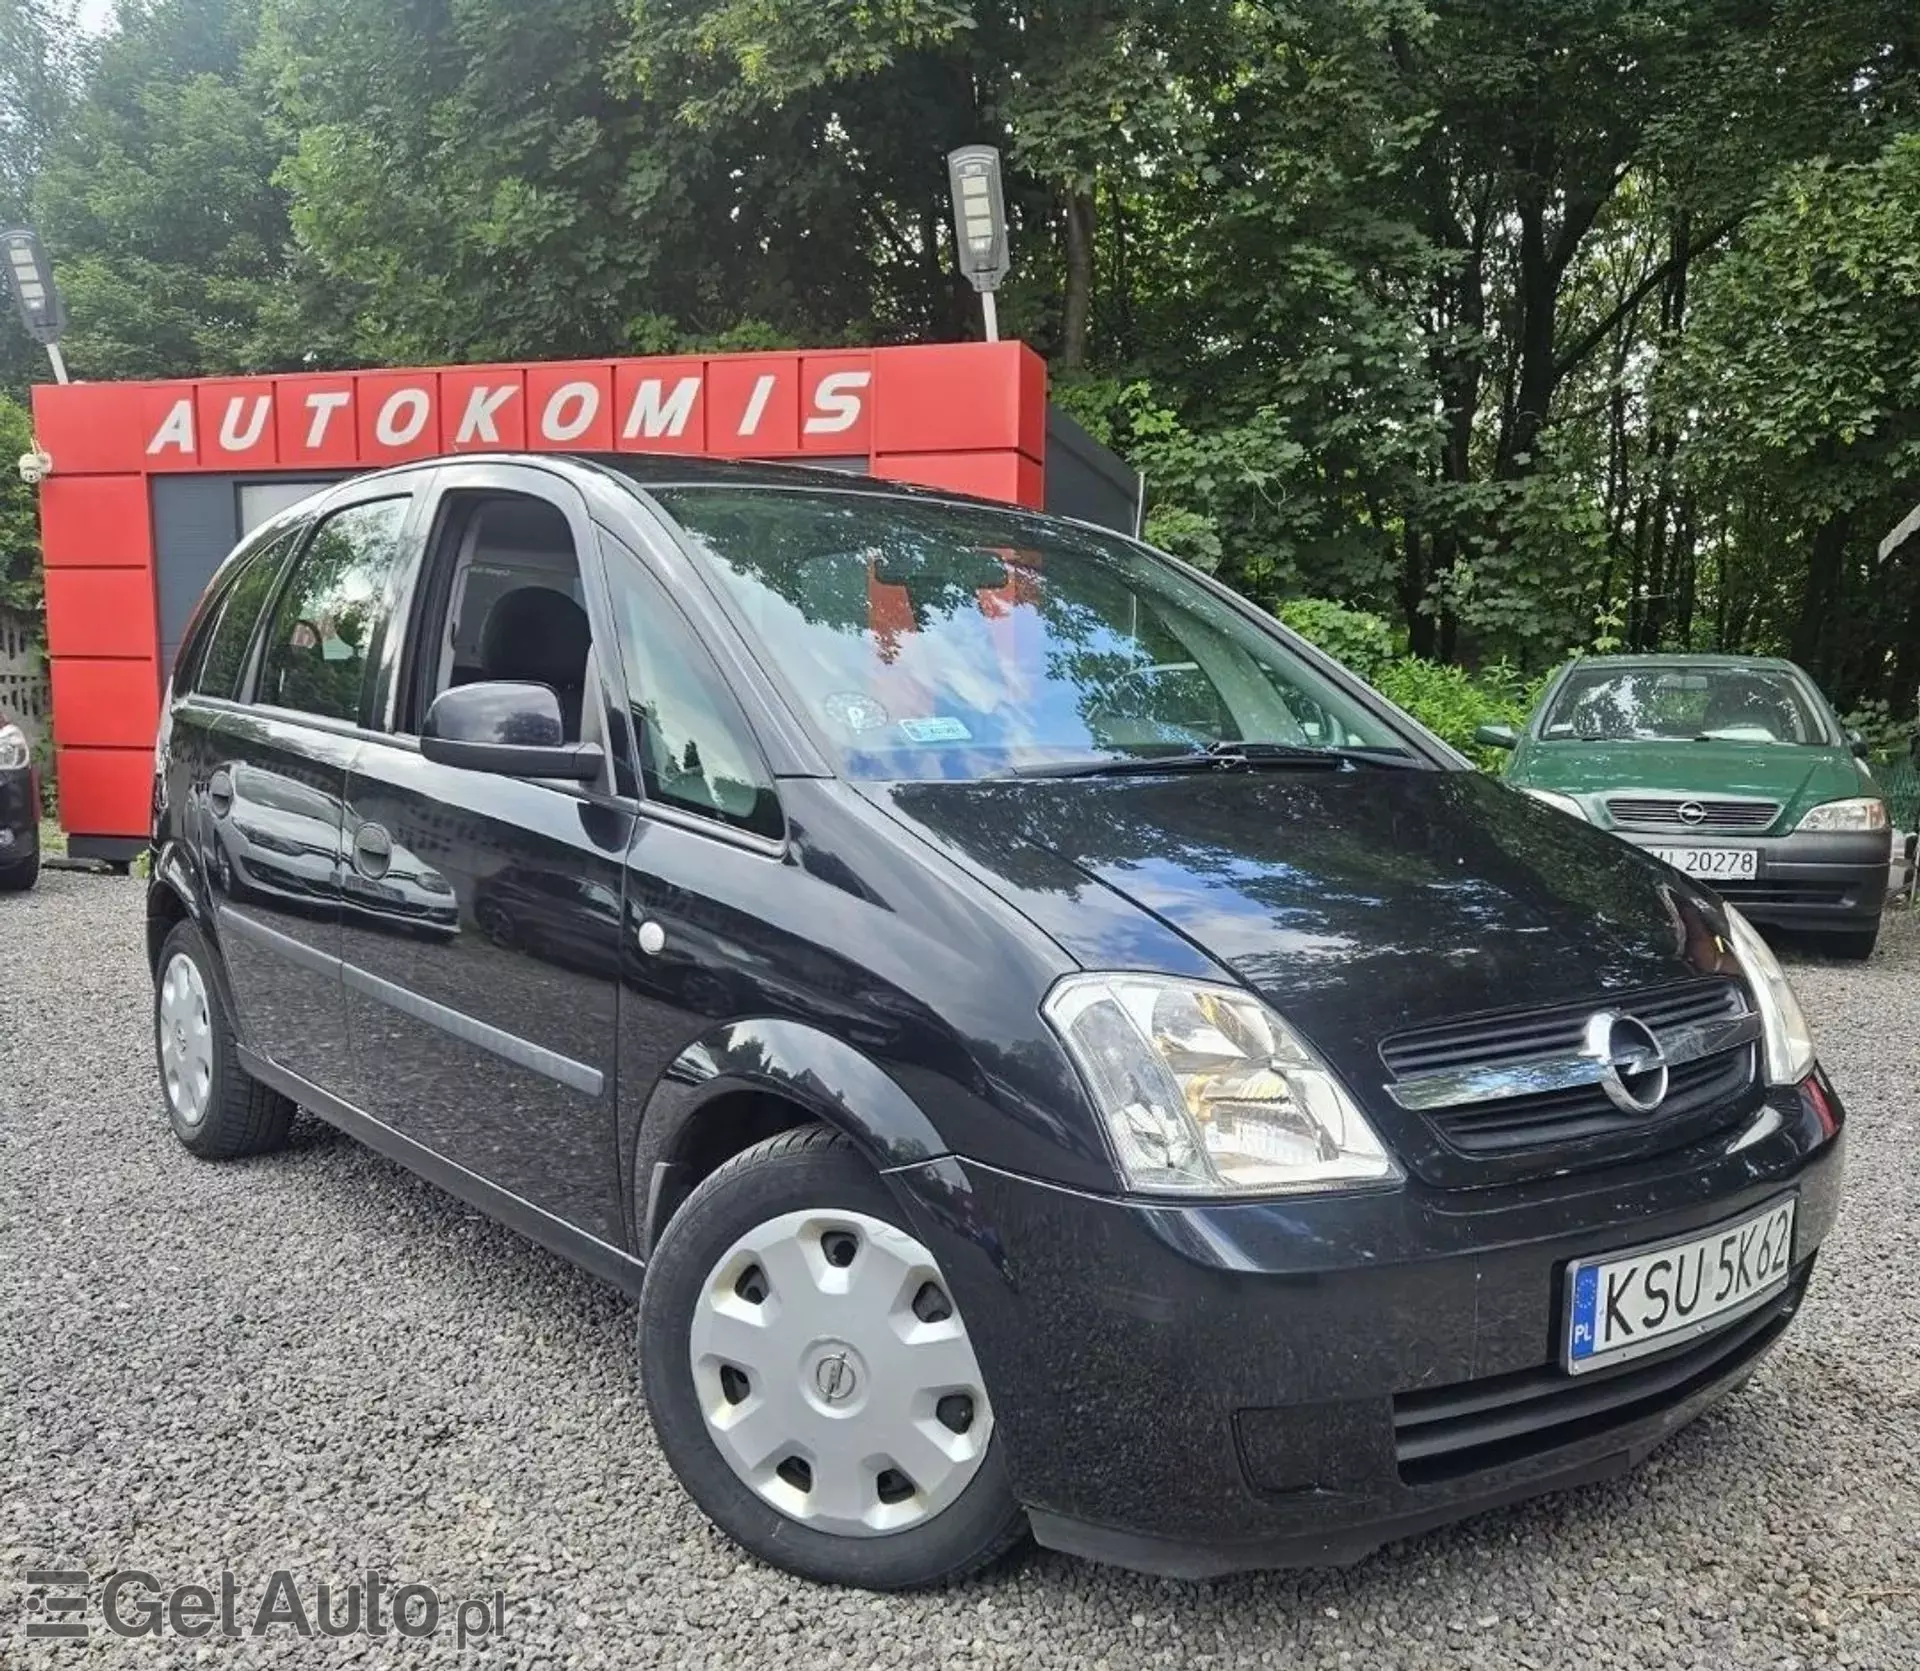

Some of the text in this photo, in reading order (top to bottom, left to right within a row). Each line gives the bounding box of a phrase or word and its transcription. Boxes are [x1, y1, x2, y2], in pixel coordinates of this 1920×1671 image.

[147, 371, 871, 454] AUTOKOMIS
[1685, 851, 1753, 873] 20278
[1605, 1209, 1788, 1341] KSU 5K62
[1574, 1323, 1591, 1343] PL
